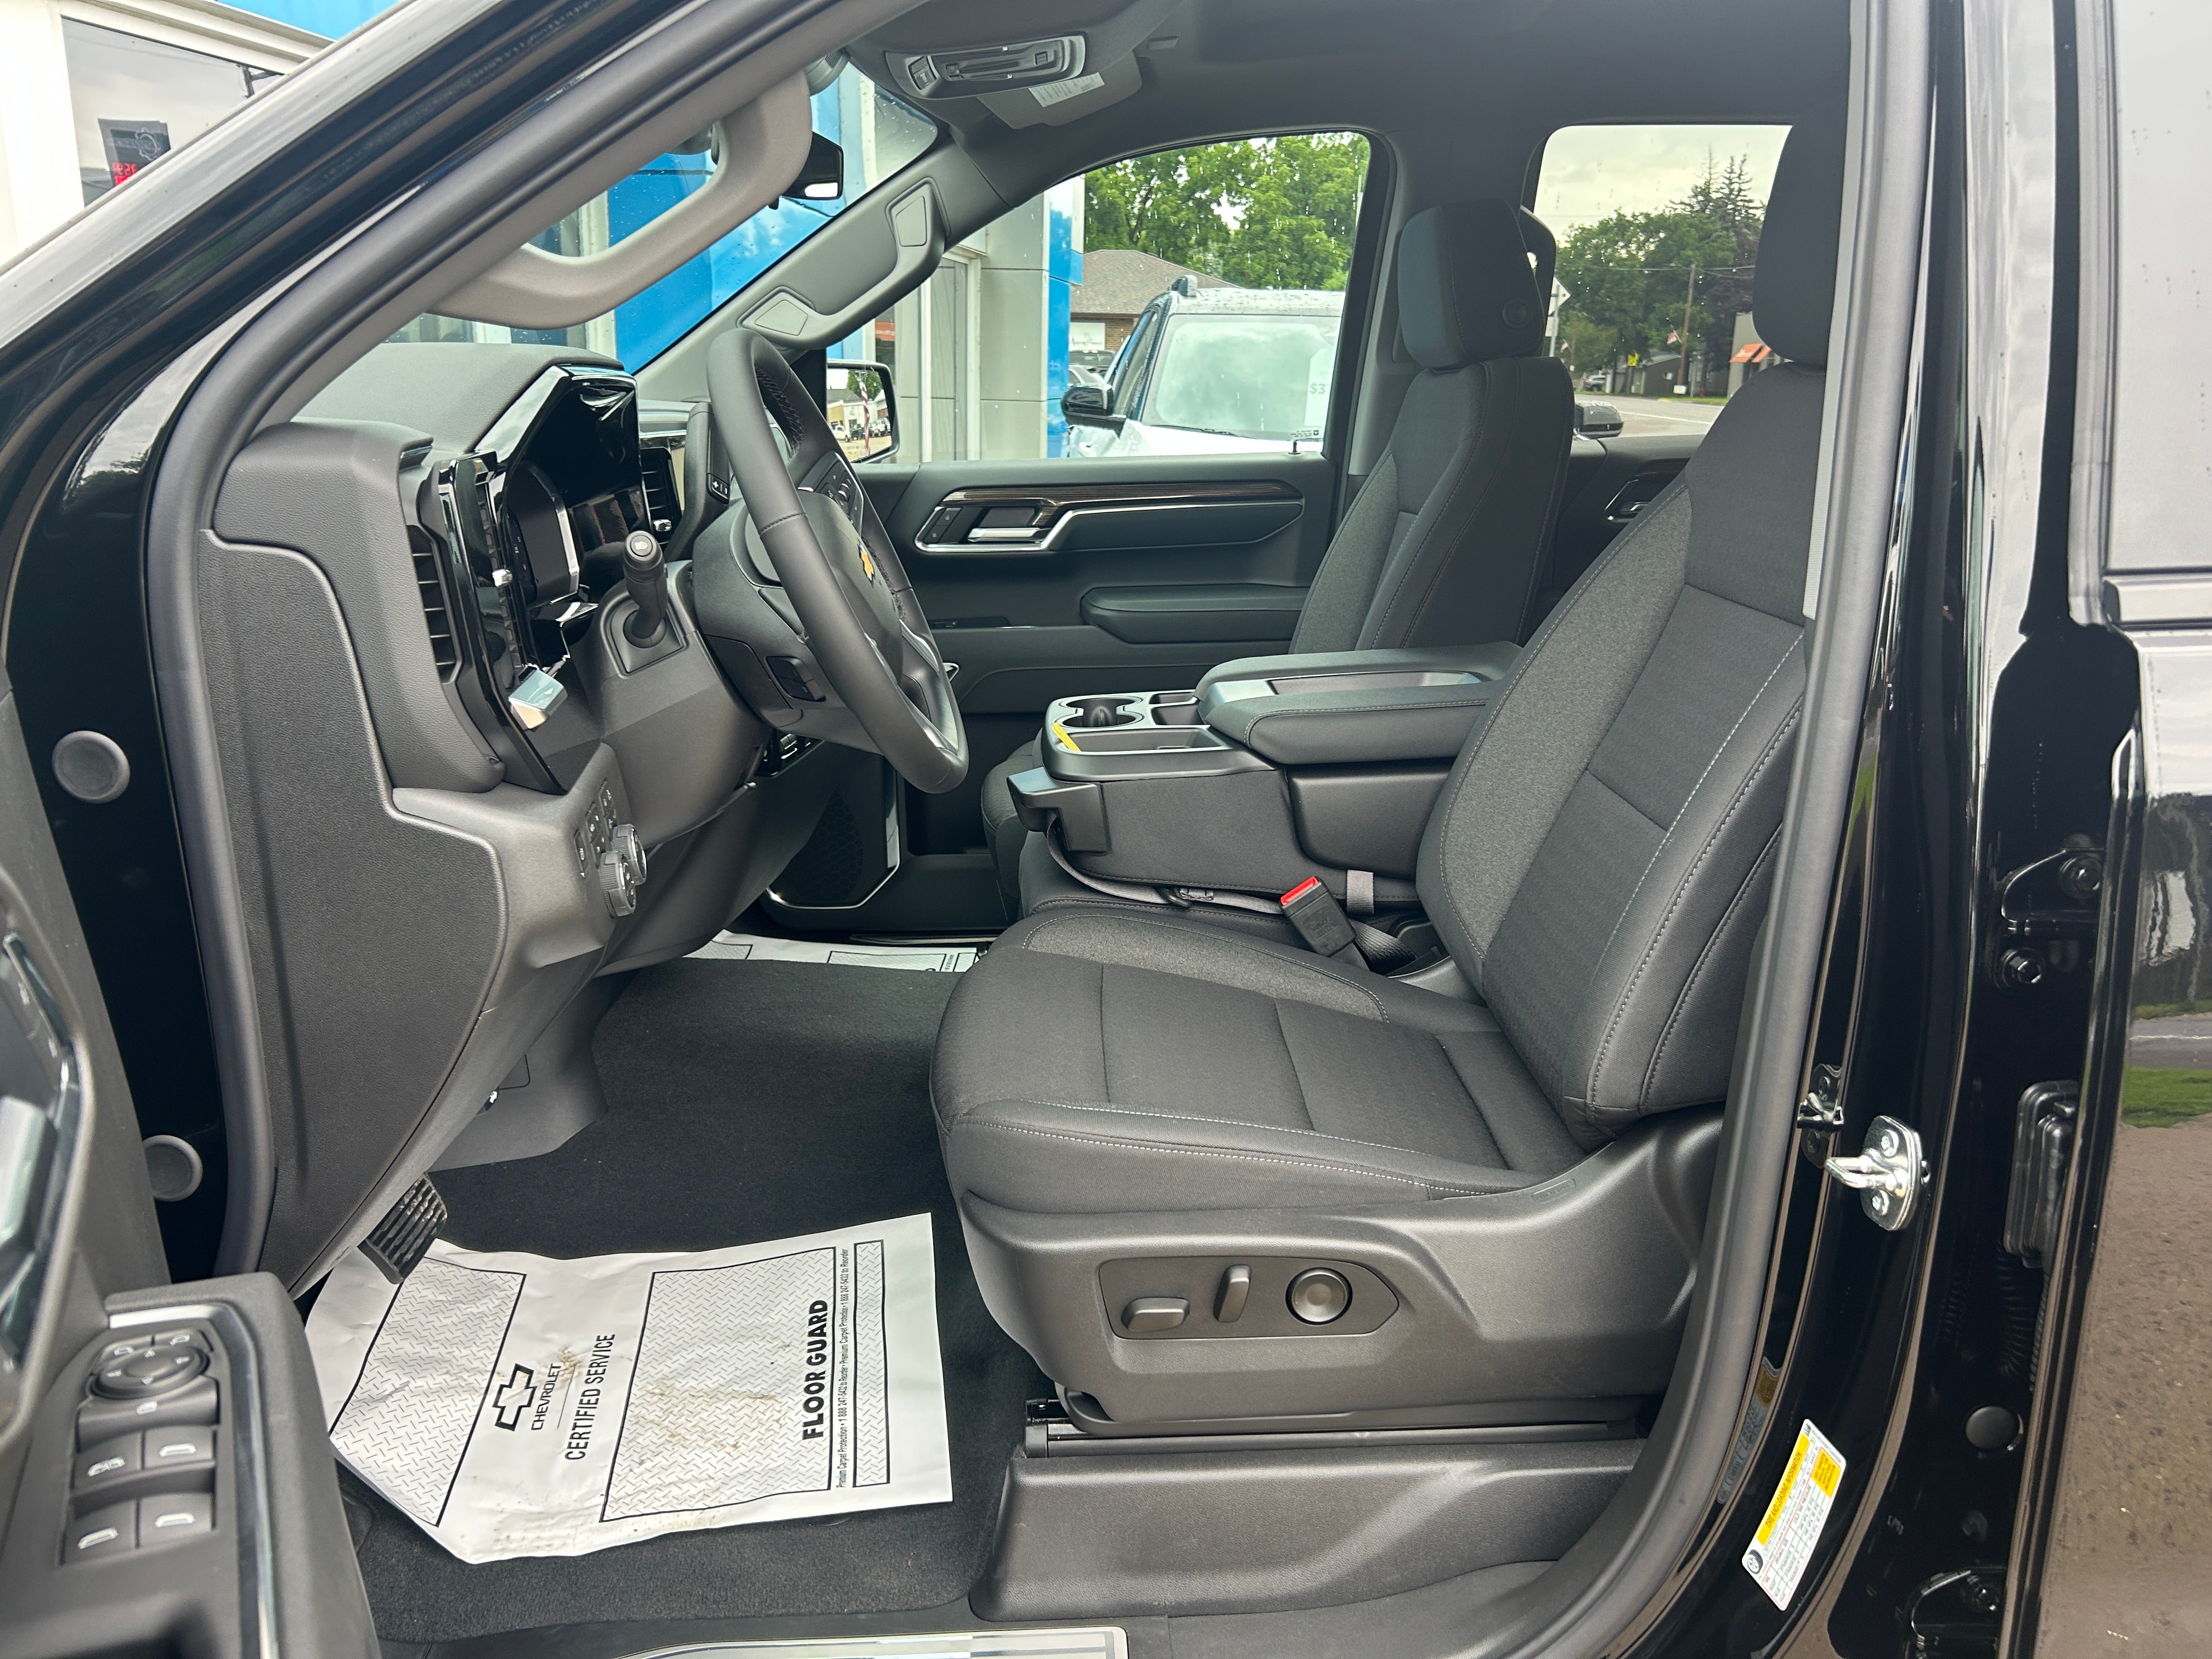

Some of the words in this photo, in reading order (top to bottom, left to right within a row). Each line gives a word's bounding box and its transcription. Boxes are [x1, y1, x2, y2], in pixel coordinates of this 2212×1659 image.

[840, 1249, 849, 1267] Reorder
[840, 1273, 849, 1293] 247-5432
[839, 1307, 849, 1327] Protection
[806, 1300, 828, 1365] GUARD
[839, 1328, 850, 1344] Carpet
[839, 1345, 848, 1364] Premium
[531, 1363, 561, 1430] CHEVROLET
[565, 1389, 601, 1460] CERTIFIED
[585, 1334, 615, 1384] SERVICE
[802, 1370, 826, 1440] FLOOR
[838, 1386, 848, 1406] 247-5432
[838, 1407, 848, 1417] 888
[838, 1427, 848, 1452] Protection
[837, 1454, 850, 1469] Carpet
[836, 1470, 847, 1488] Premium
[1765, 1514, 1774, 1529] TIRE
[1770, 1503, 1779, 1517] AND
[1775, 1481, 1788, 1506] LOADING
[1785, 1450, 1801, 1485] INFORMATION
